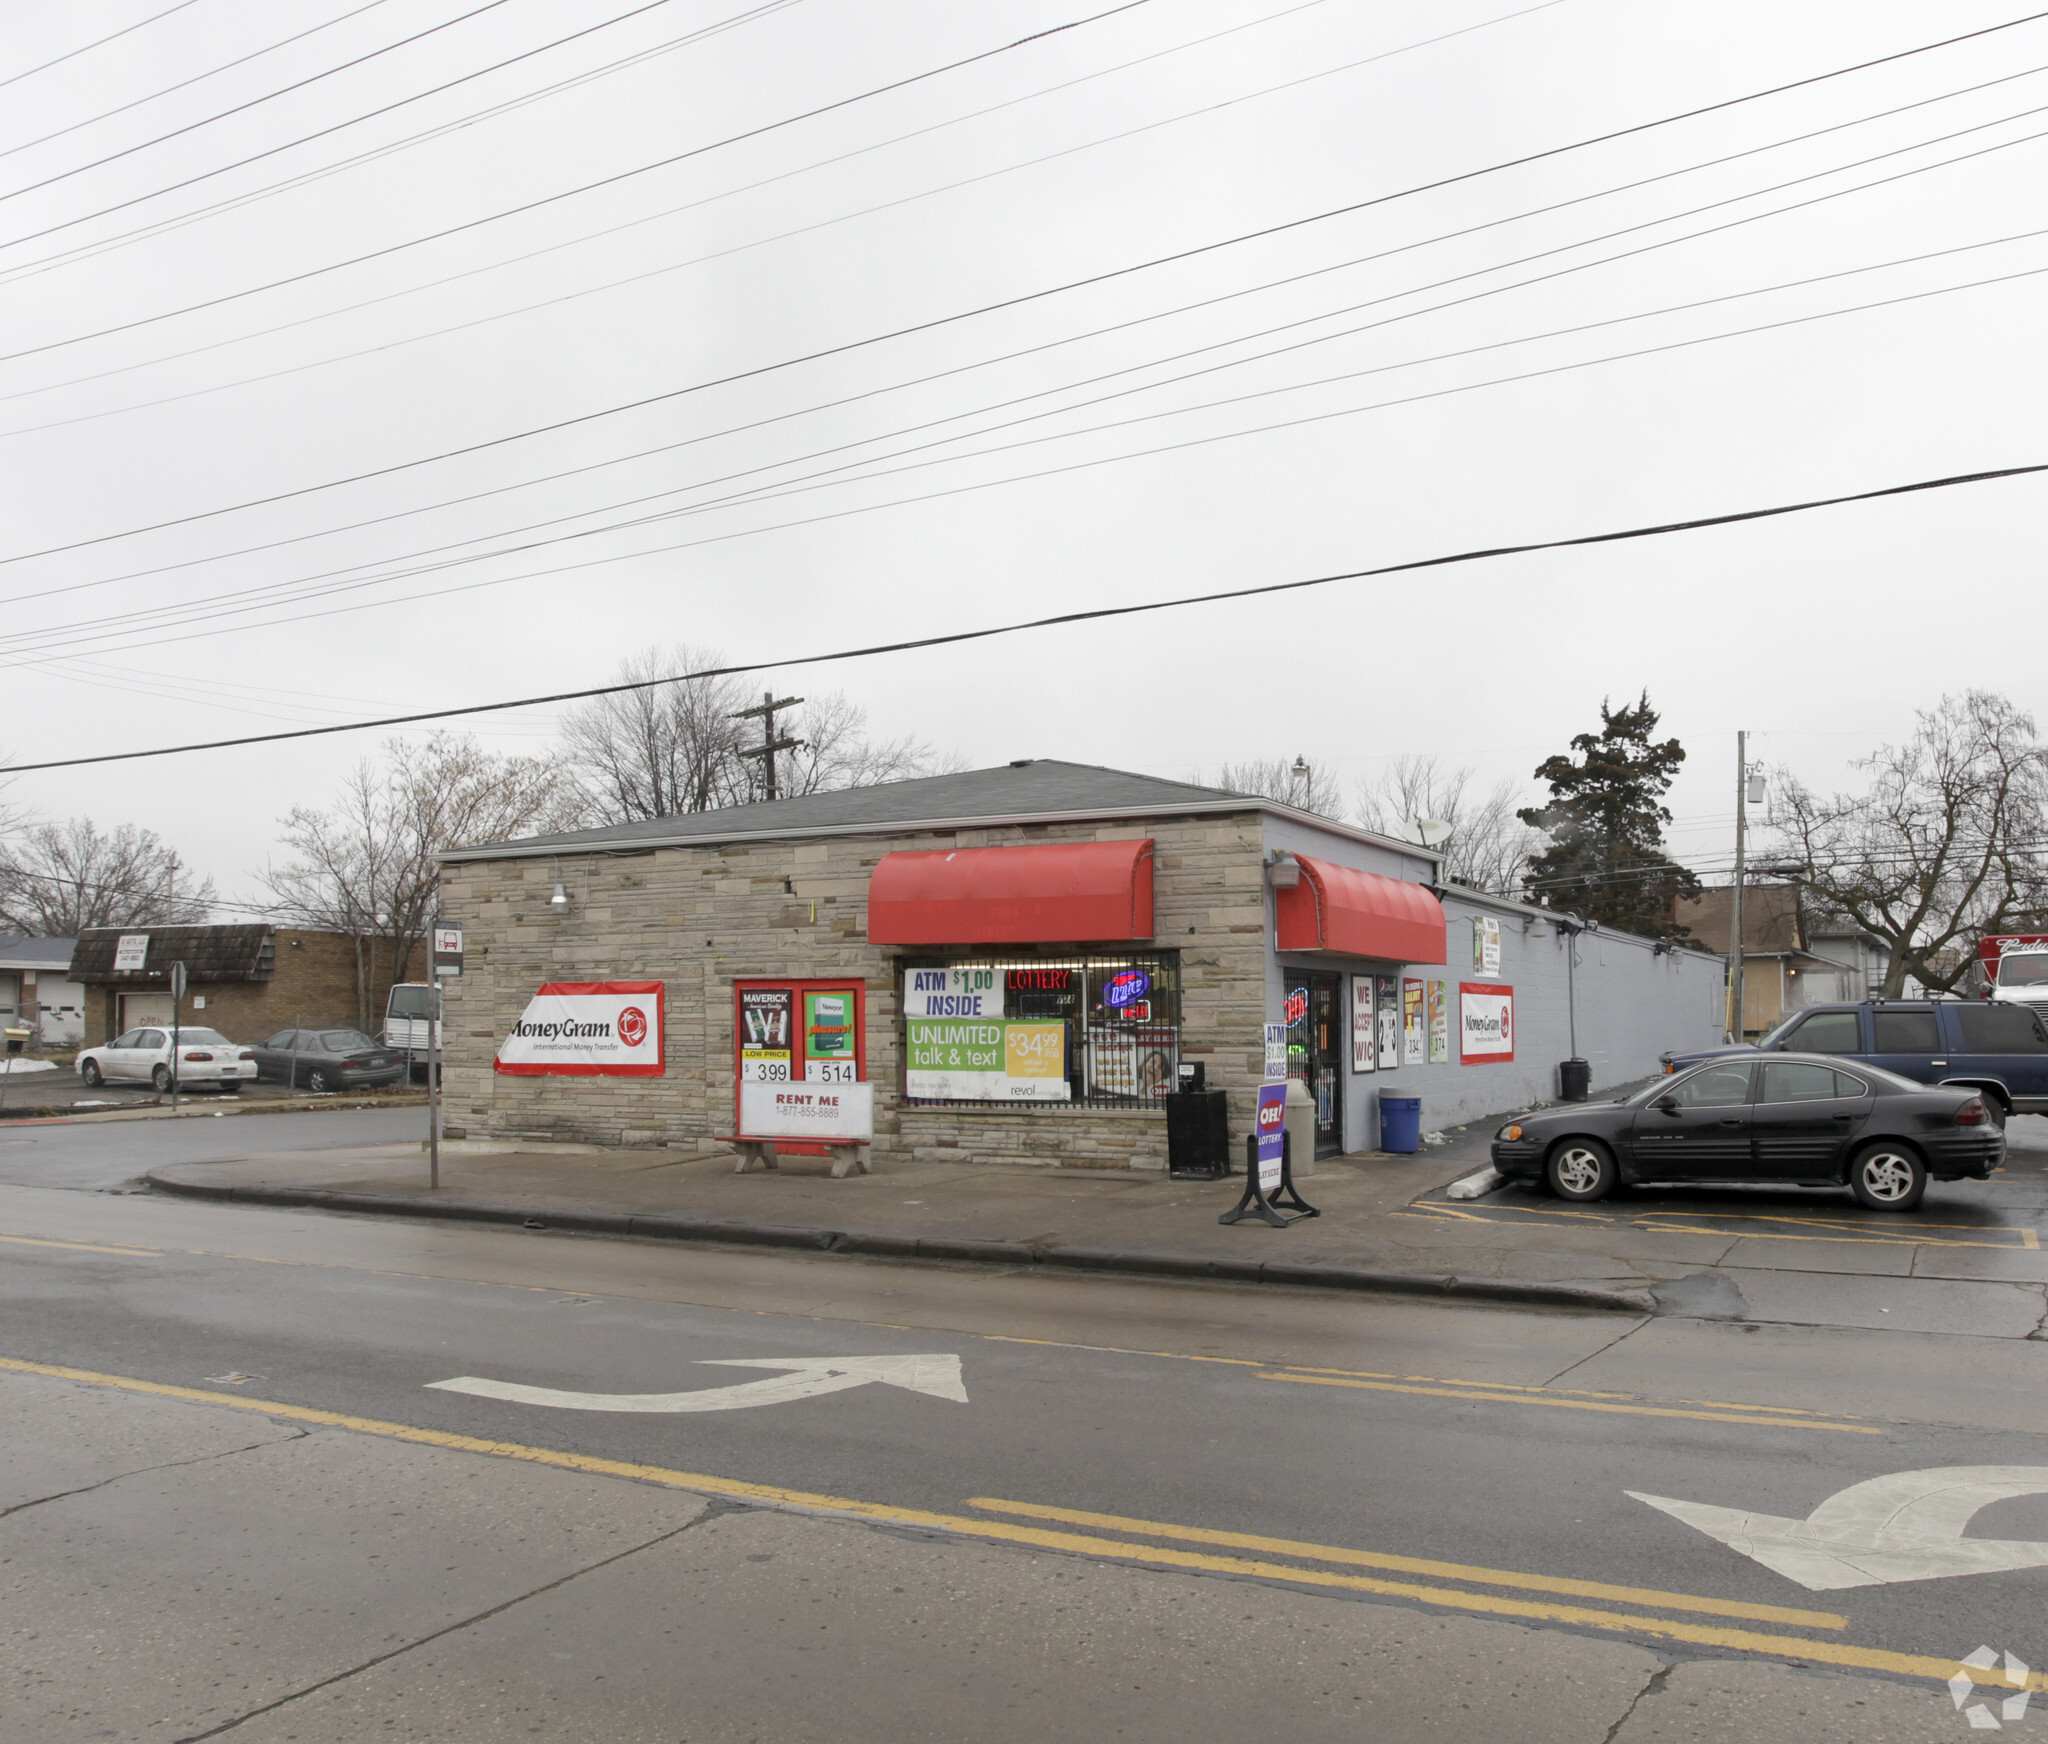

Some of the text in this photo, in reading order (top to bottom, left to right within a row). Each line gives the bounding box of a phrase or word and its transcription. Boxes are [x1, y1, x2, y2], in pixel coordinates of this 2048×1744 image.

[914, 971, 993, 994] ATM $1.00
[1008, 970, 1070, 989] LOTTERY
[743, 993, 787, 1003] MAVERICK
[1357, 985, 1370, 1004] WE
[822, 1003, 842, 1011] Newport
[926, 995, 982, 1015] INSIDE
[512, 1018, 610, 1041] MoneyGram
[808, 1024, 852, 1036] pleasure!
[1354, 1013, 1373, 1031] ACCEPT
[911, 1026, 1000, 1045] UNLIMITED
[1267, 1025, 1285, 1044] ATM
[533, 1043, 619, 1052] International Money Transfer
[914, 1047, 997, 1065] talk & text
[1267, 1045, 1285, 1060] $1.00
[1354, 1041, 1373, 1061] WIC
[758, 1064, 787, 1081] 399
[822, 1065, 852, 1082] 514
[1265, 1062, 1285, 1077] INSIDE
[1011, 1084, 1036, 1096] revol
[776, 1094, 839, 1106] RENT ME
[776, 1106, 839, 1118] 1-877-855-8889
[1260, 1104, 1283, 1125] OH!
[1258, 1133, 1281, 1146] LOTTERY
